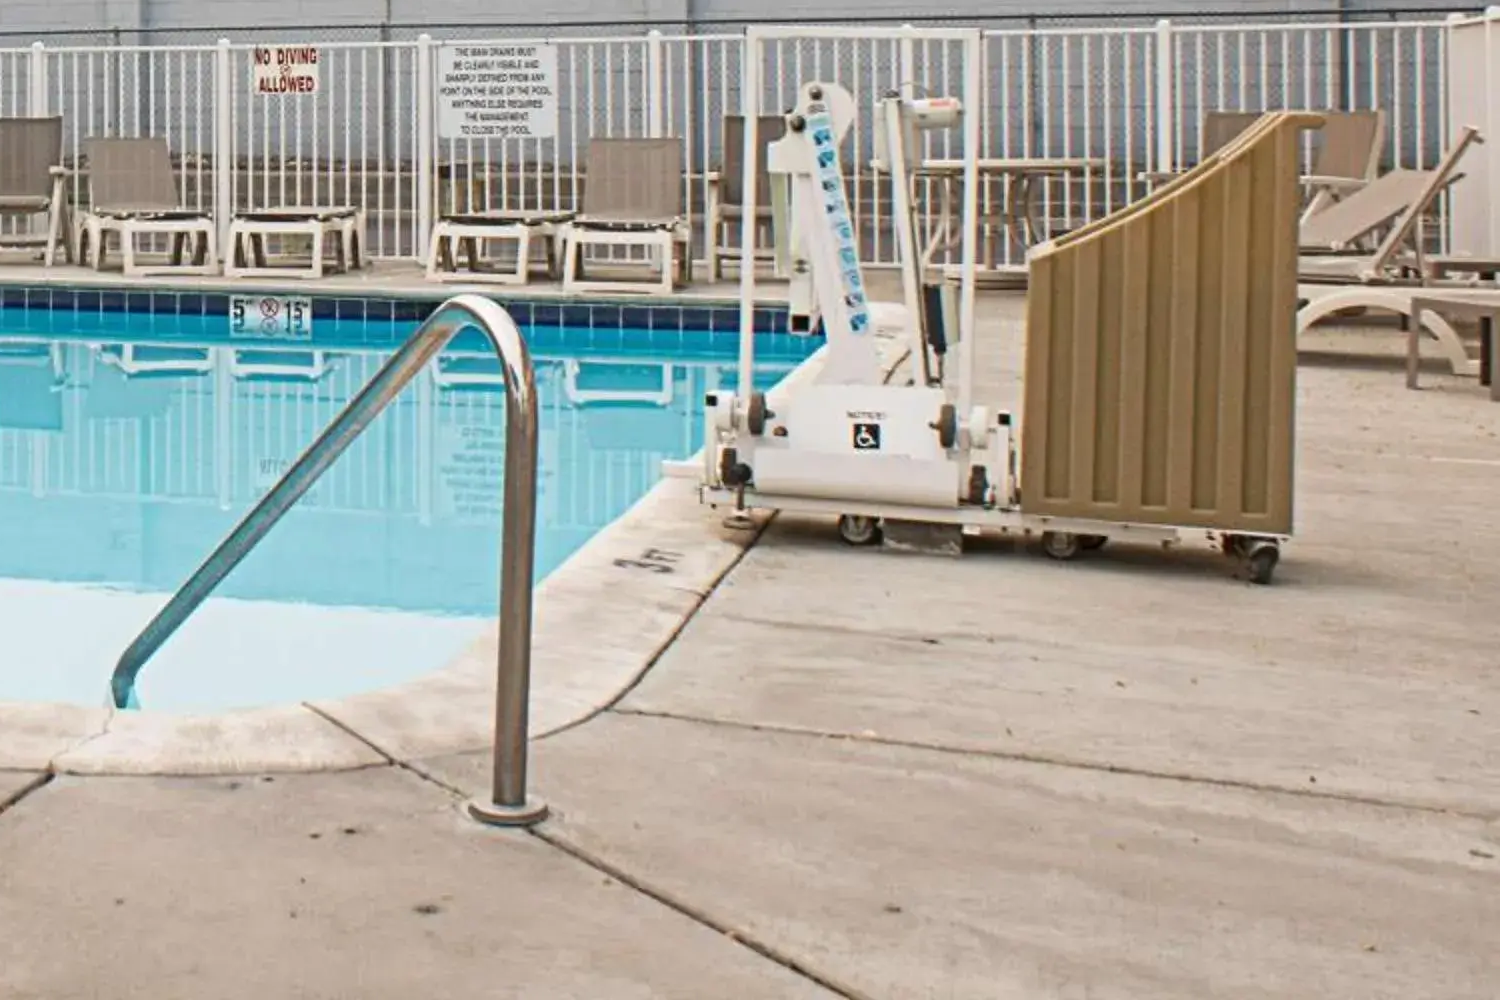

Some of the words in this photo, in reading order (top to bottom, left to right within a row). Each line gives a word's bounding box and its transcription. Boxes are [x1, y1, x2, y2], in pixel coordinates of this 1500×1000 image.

[254, 47, 271, 65] NO
[277, 47, 317, 65] DIVING
[455, 47, 469, 56] THE
[453, 60, 463, 70] BE
[524, 60, 539, 70] AND
[509, 74, 529, 83] FROM
[531, 74, 545, 83] ANY
[259, 76, 315, 93] ALLOWED
[440, 86, 460, 96] POINT
[462, 86, 473, 96] ON
[474, 86, 486, 96] THE
[506, 86, 516, 96] OF
[517, 86, 529, 96] THE
[465, 112, 478, 121] THE
[461, 125, 470, 134] TO
[233, 299, 245, 318] 5
